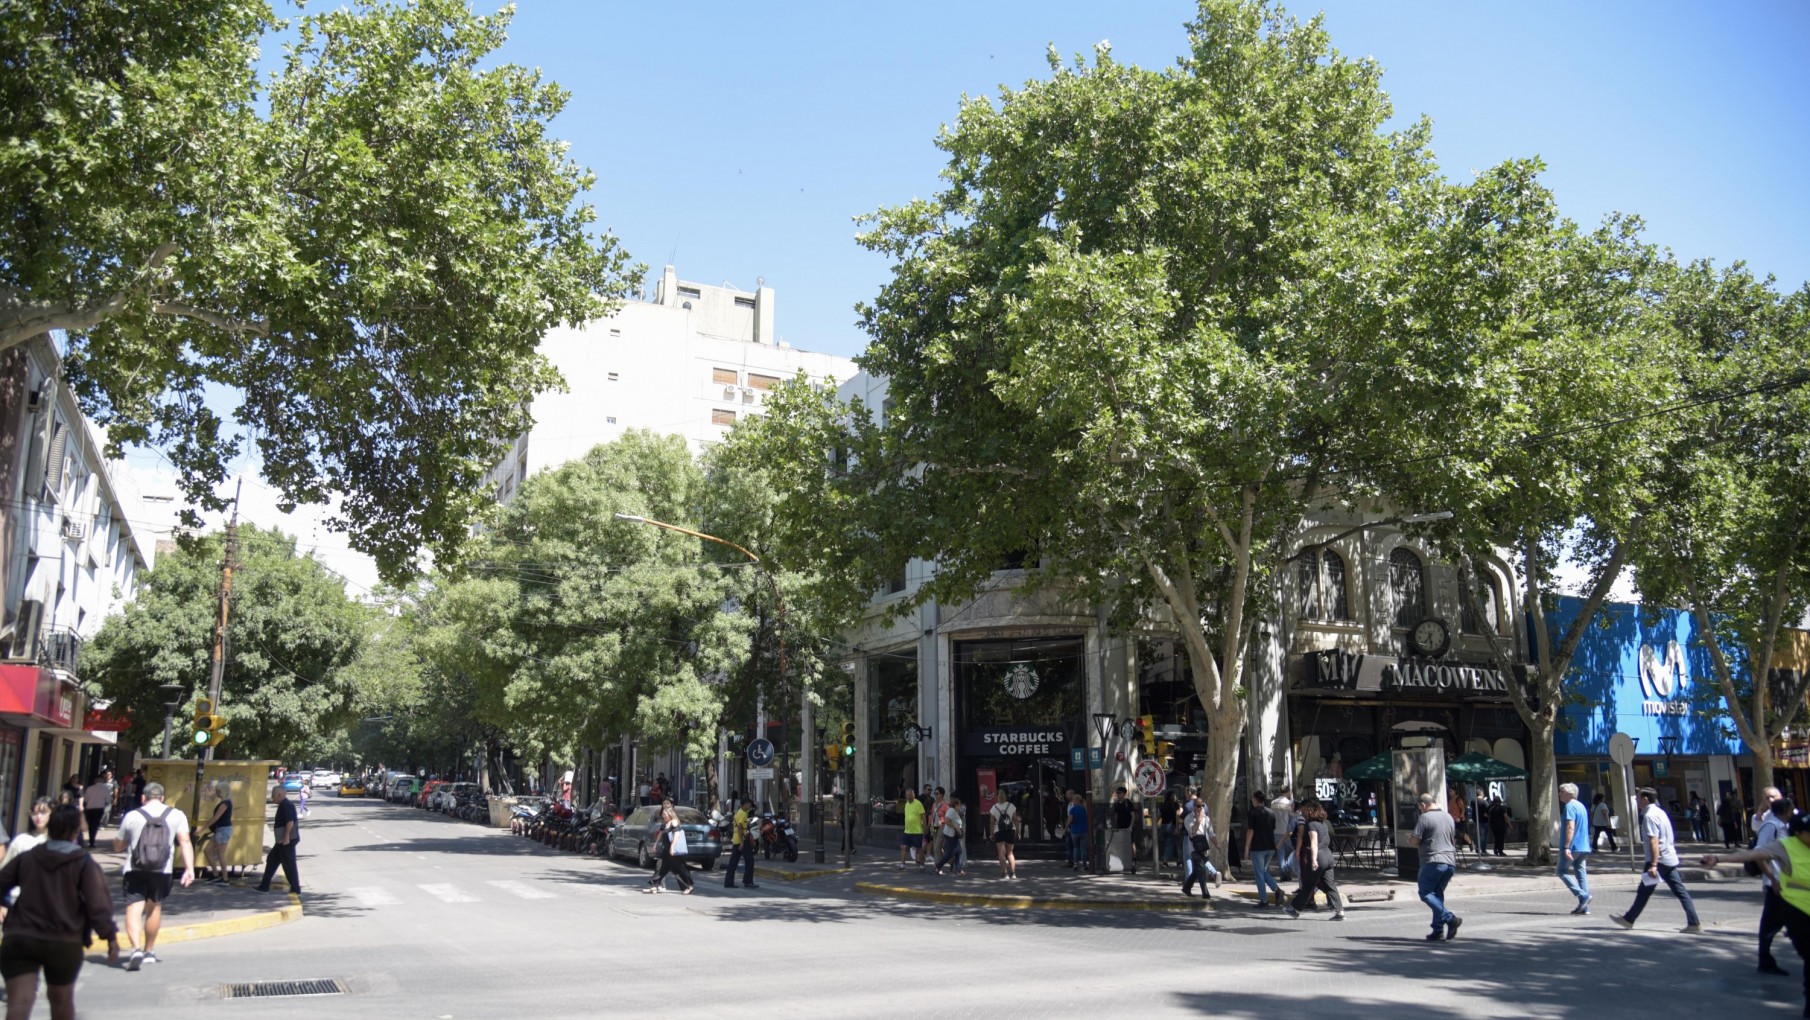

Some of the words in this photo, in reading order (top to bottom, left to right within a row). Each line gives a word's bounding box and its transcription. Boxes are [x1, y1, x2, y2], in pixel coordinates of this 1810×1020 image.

[1391, 663, 1508, 691] MACOWENS
[983, 732, 1064, 743] STARBUCKS
[999, 744, 1049, 755] COFFEE
